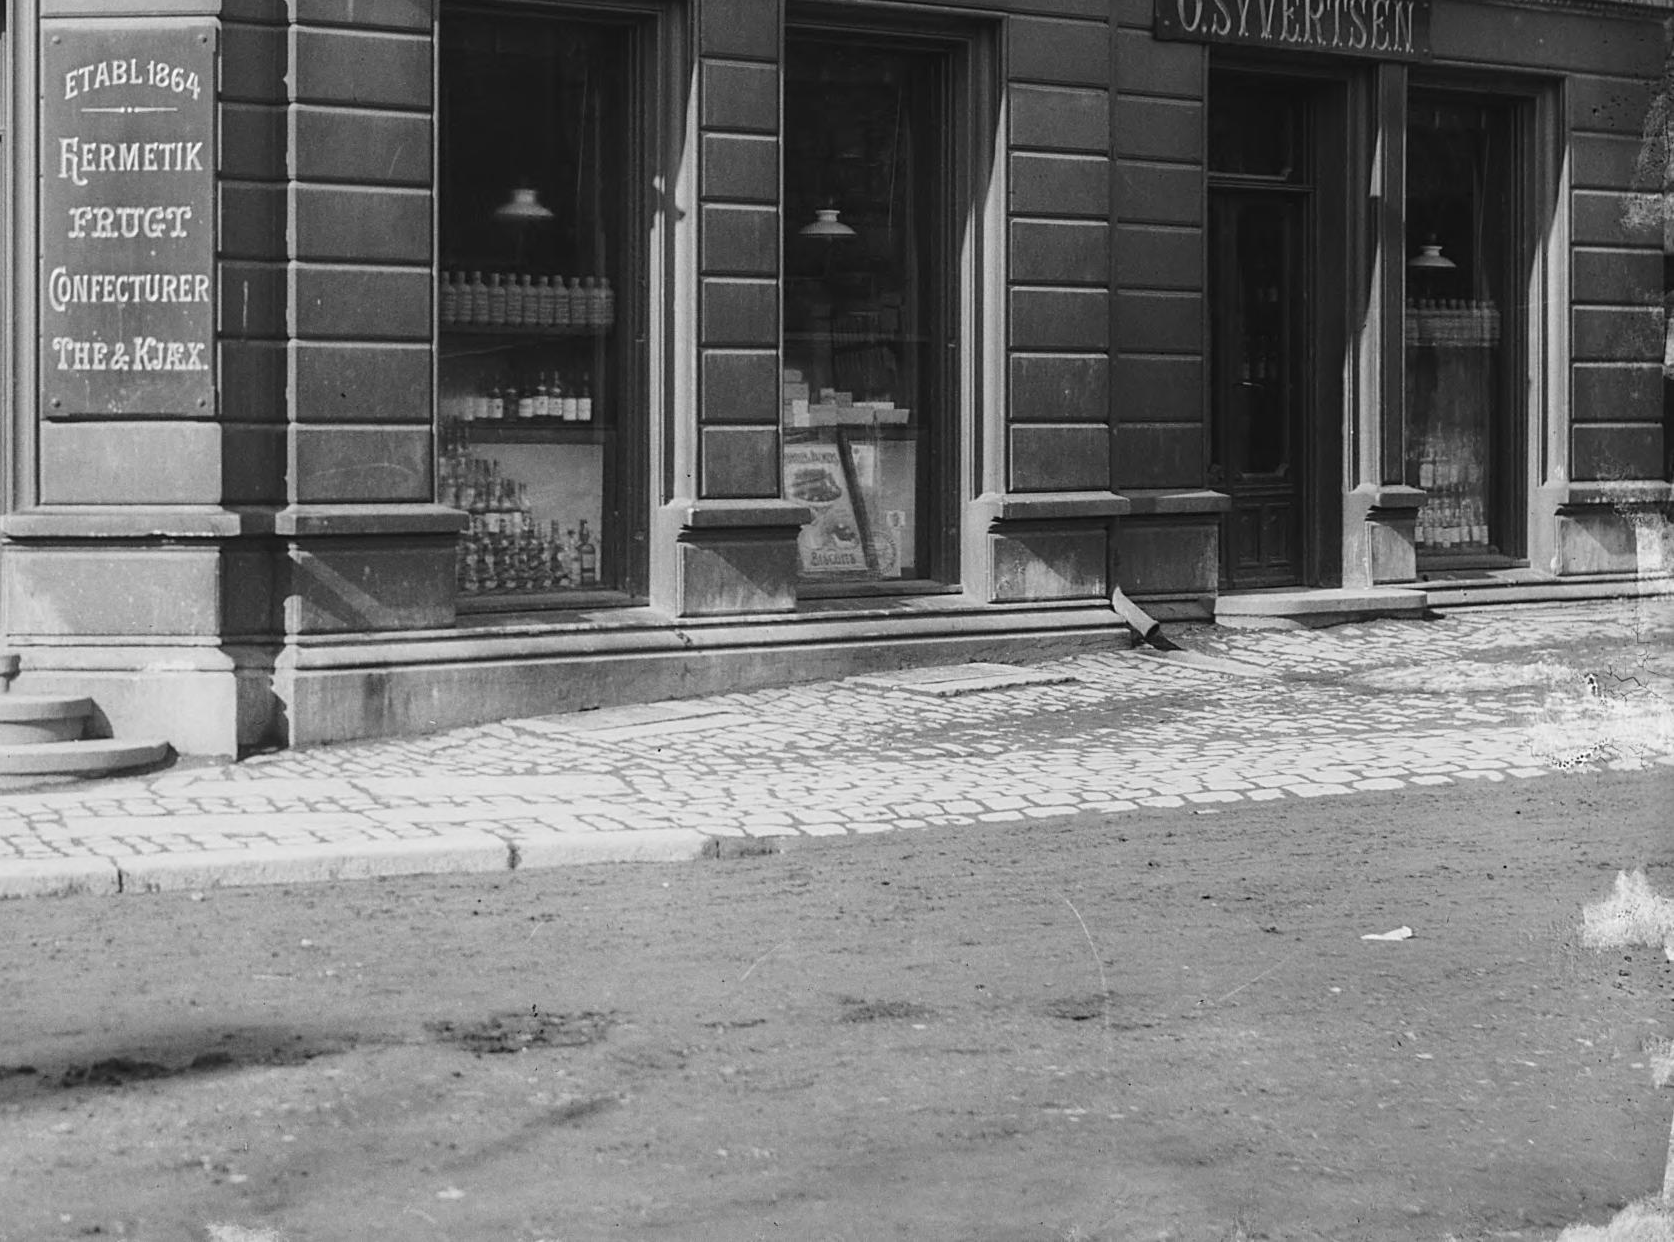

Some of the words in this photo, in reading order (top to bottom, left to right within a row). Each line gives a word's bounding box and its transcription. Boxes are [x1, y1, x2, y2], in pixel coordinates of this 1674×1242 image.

[64, 58, 143, 100] ETABL
[146, 60, 201, 100] 1864
[68, 206, 193, 239] FRUGT
[48, 265, 210, 312] CONFECTURER
